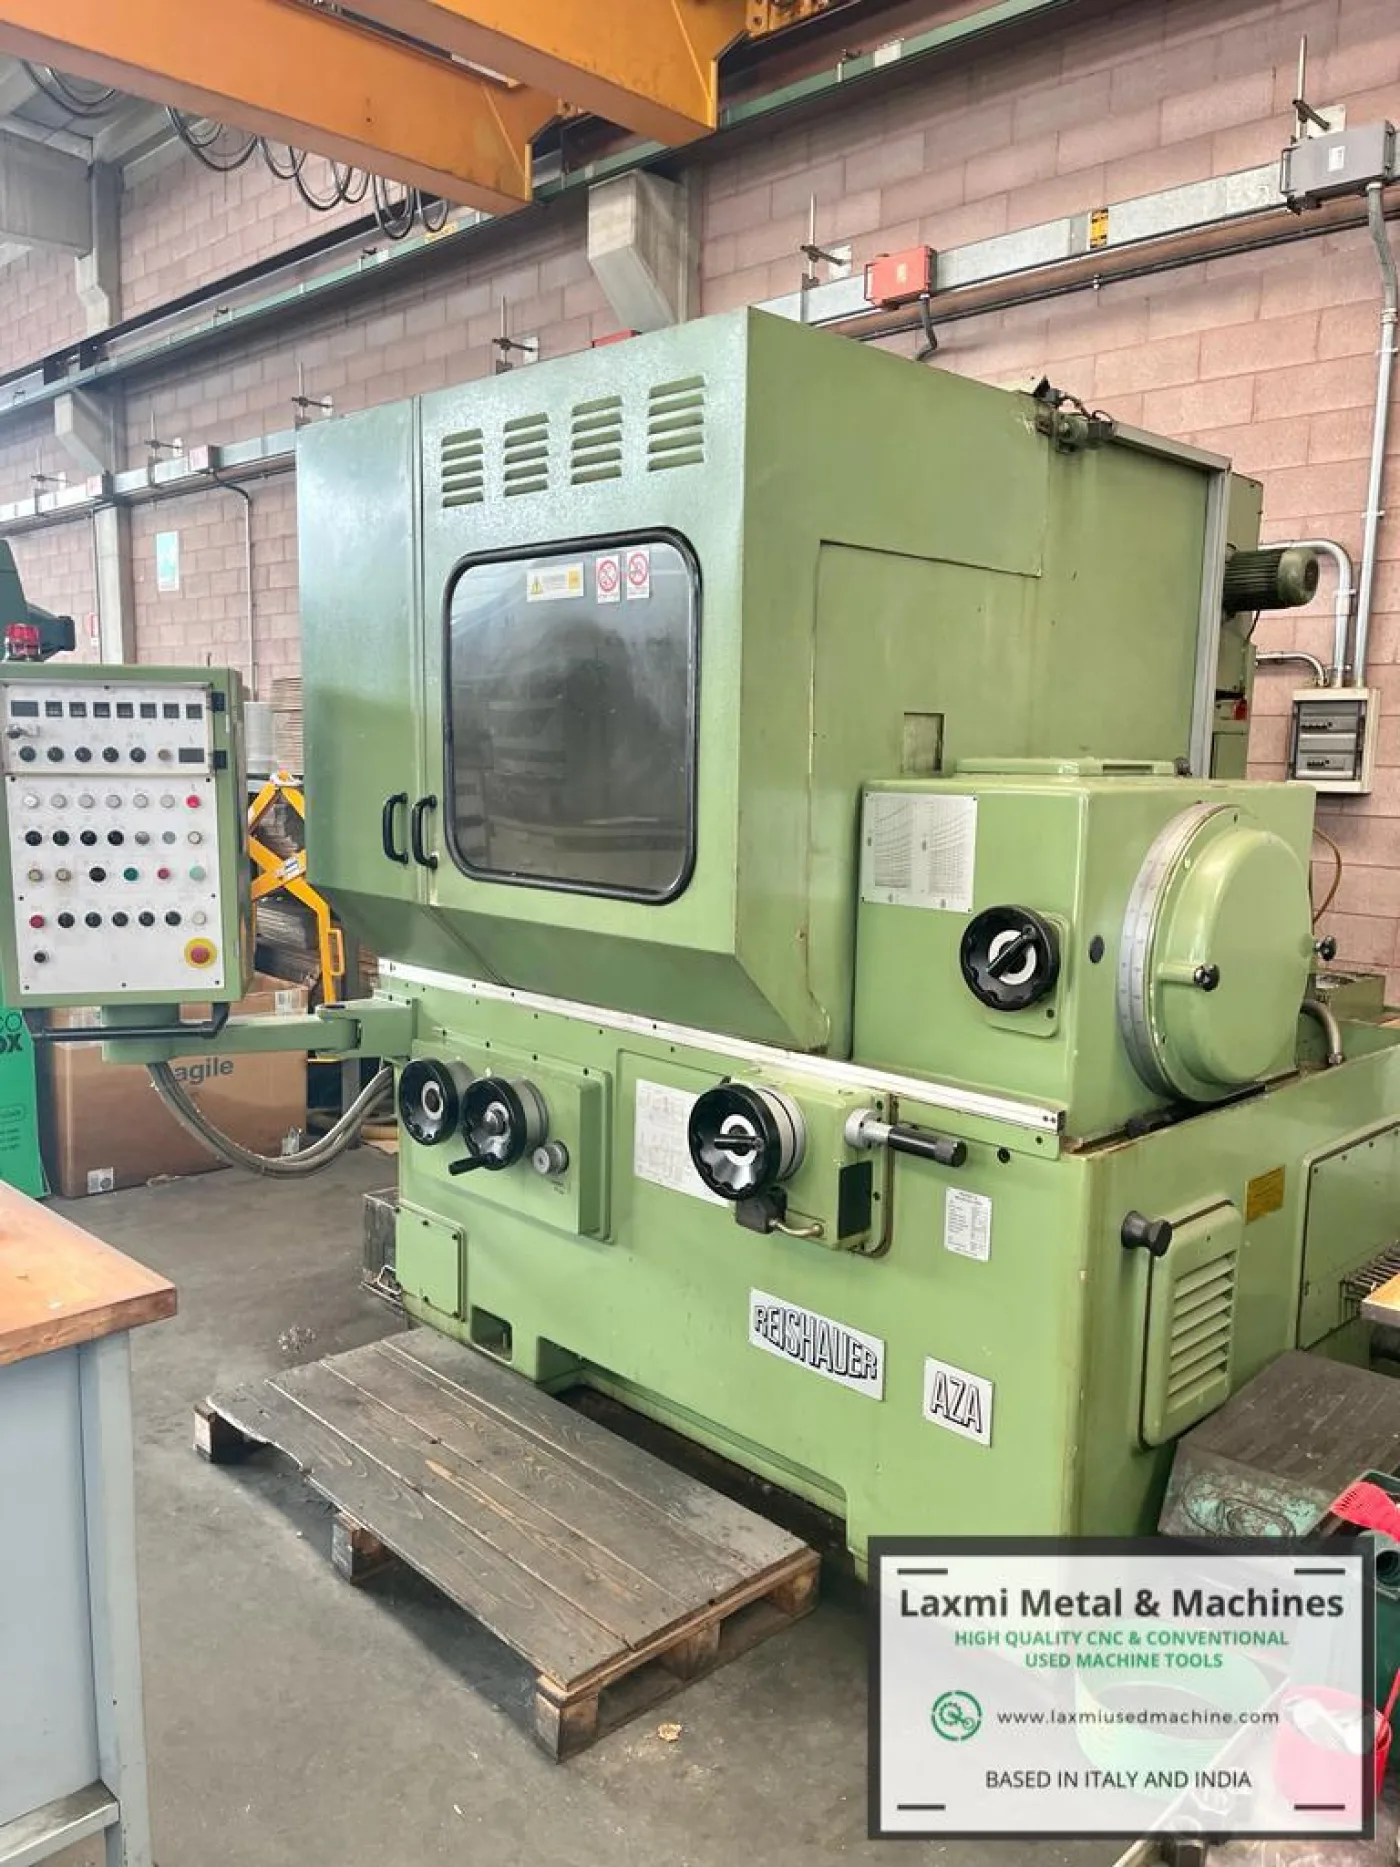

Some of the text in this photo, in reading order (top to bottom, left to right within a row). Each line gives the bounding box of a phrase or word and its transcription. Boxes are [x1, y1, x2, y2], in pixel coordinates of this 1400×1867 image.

[174, 1056, 234, 1086] agile
[754, 1305, 878, 1380] REISHAUER
[930, 1370, 982, 1434] AZA
